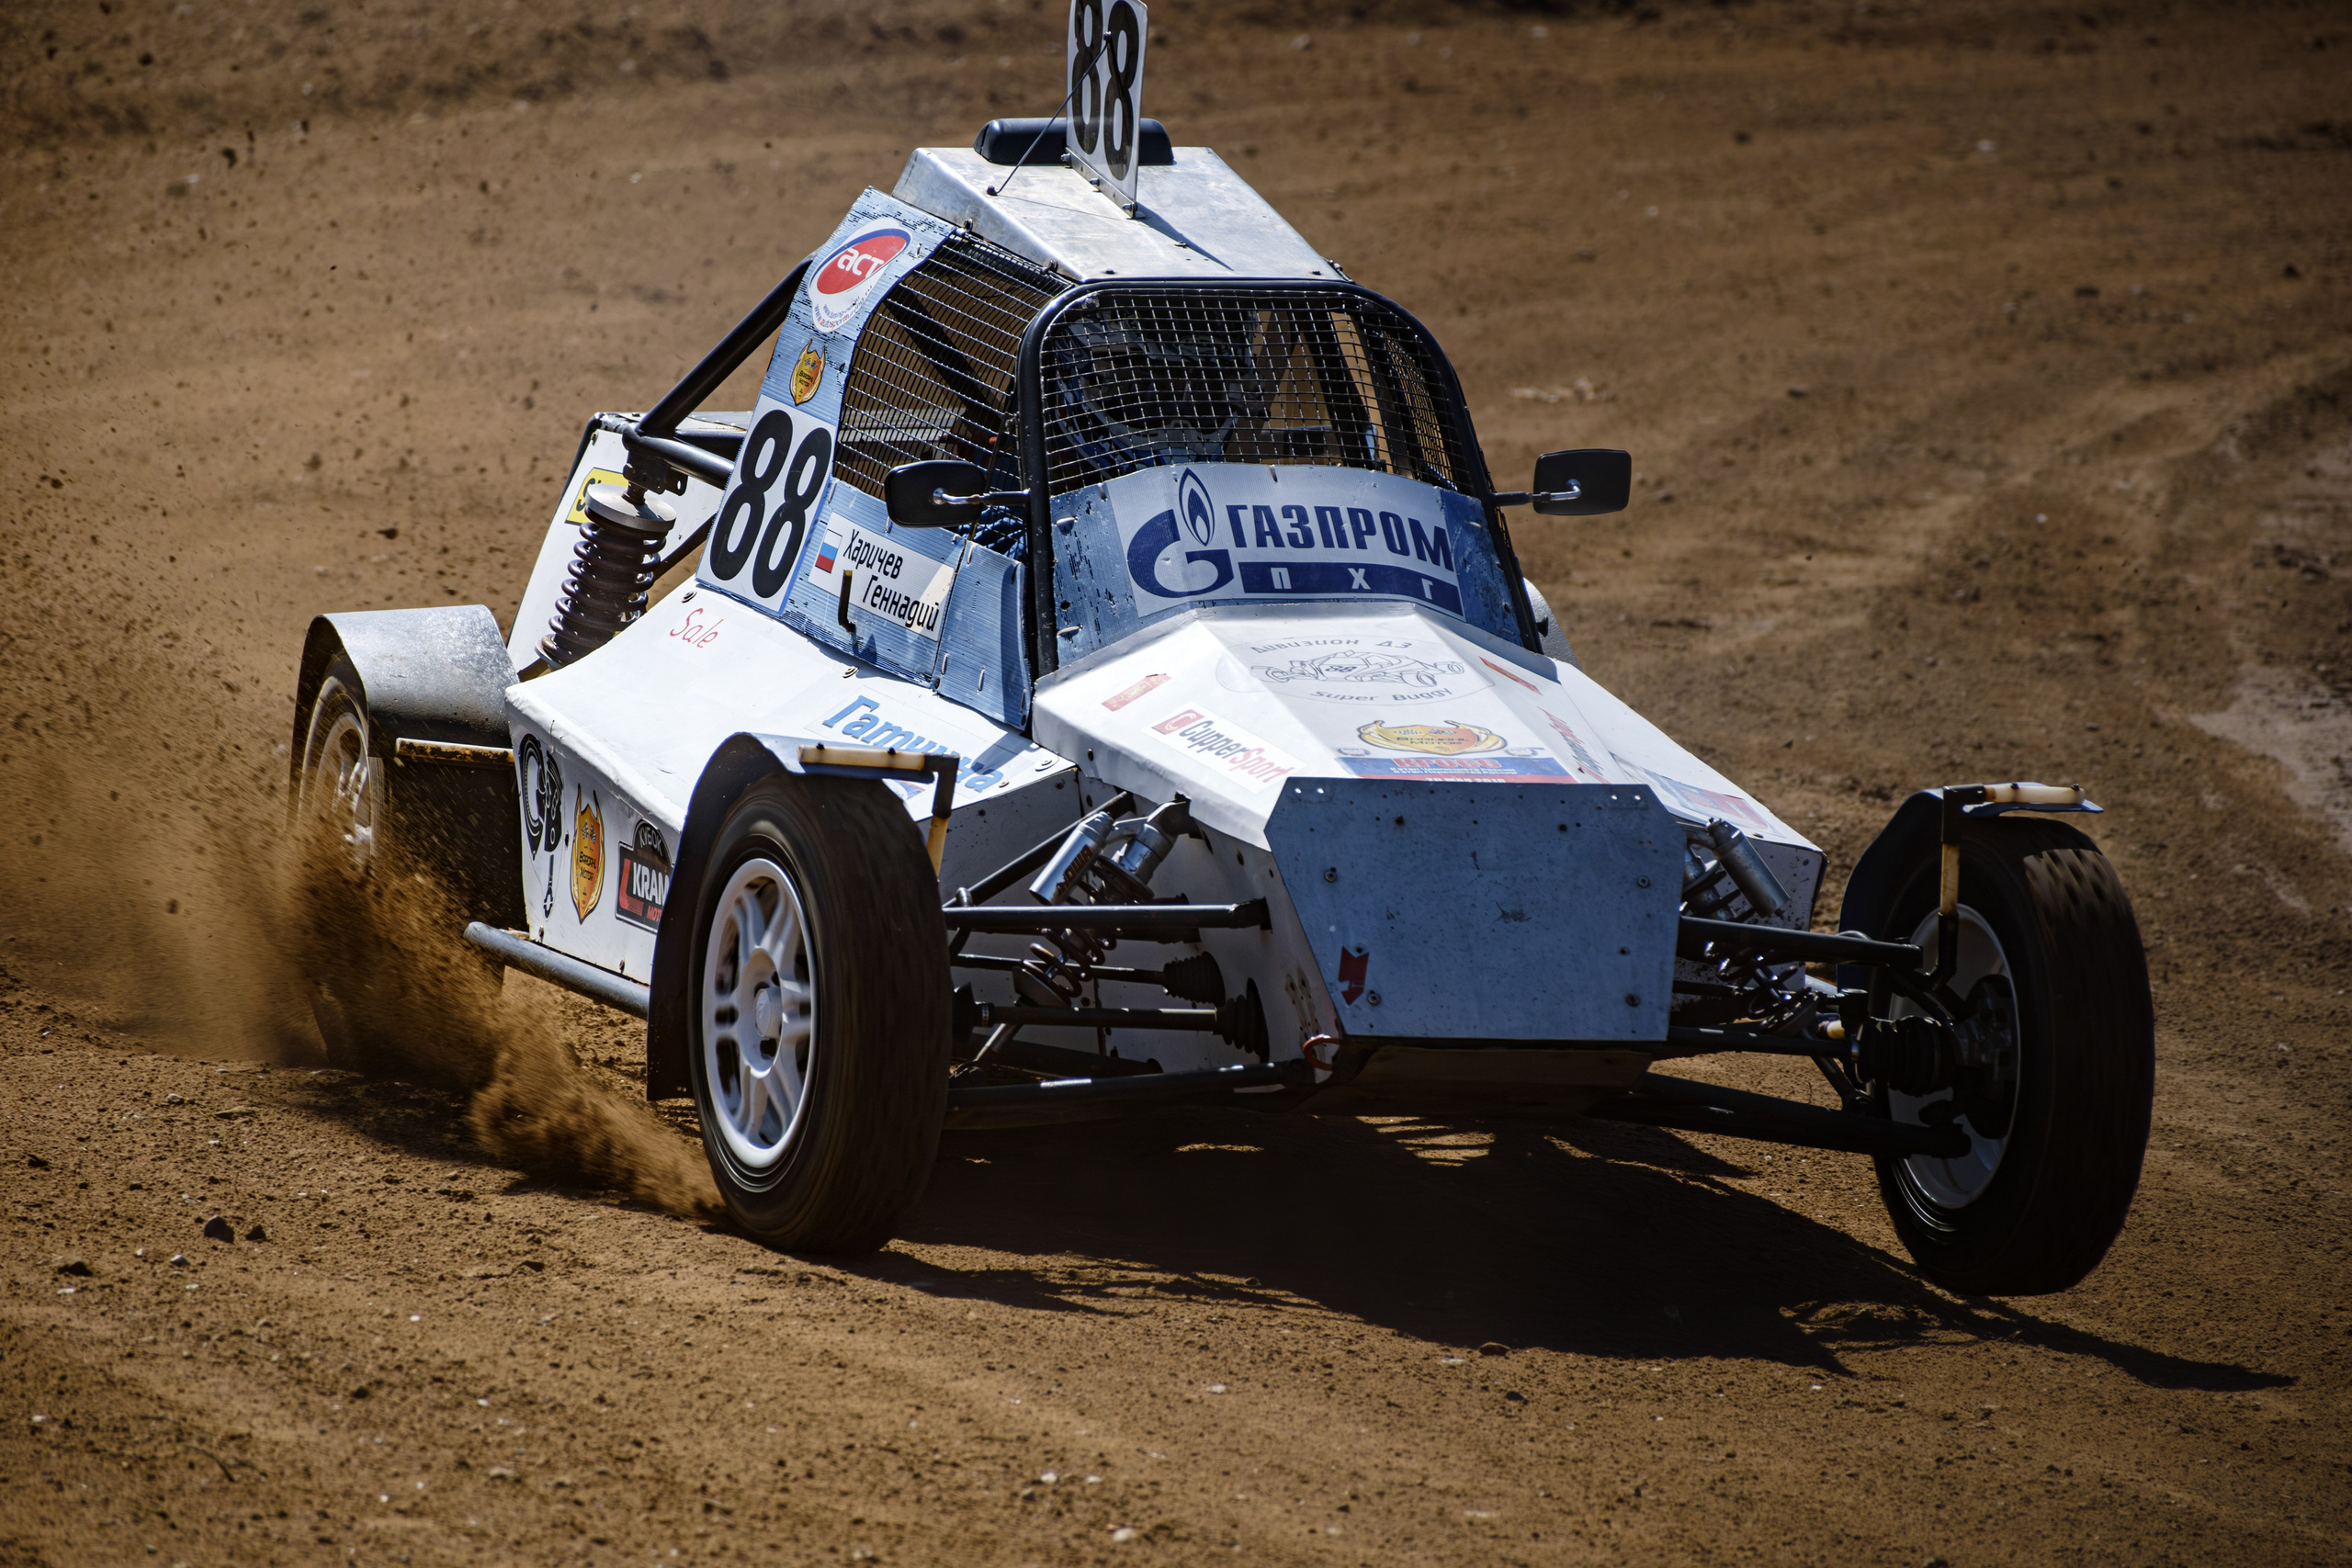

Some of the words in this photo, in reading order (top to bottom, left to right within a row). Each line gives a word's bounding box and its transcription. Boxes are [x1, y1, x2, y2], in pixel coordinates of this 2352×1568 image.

[1072, 0, 1139, 181] 88
[710, 410, 832, 599] 88
[842, 529, 903, 580] Харичев
[1227, 504, 1453, 571] ГАЗПРОМ
[862, 575, 940, 632] Геннадий
[670, 607, 724, 649] Sale
[1250, 639, 1360, 653] Дивизион
[1325, 664, 1358, 673] 88
[1310, 691, 1380, 702] Super
[1392, 688, 1453, 701] Buggy
[1179, 720, 1296, 784] CupperSport
[632, 862, 671, 908] KRAM
[646, 905, 662, 922] MOT
